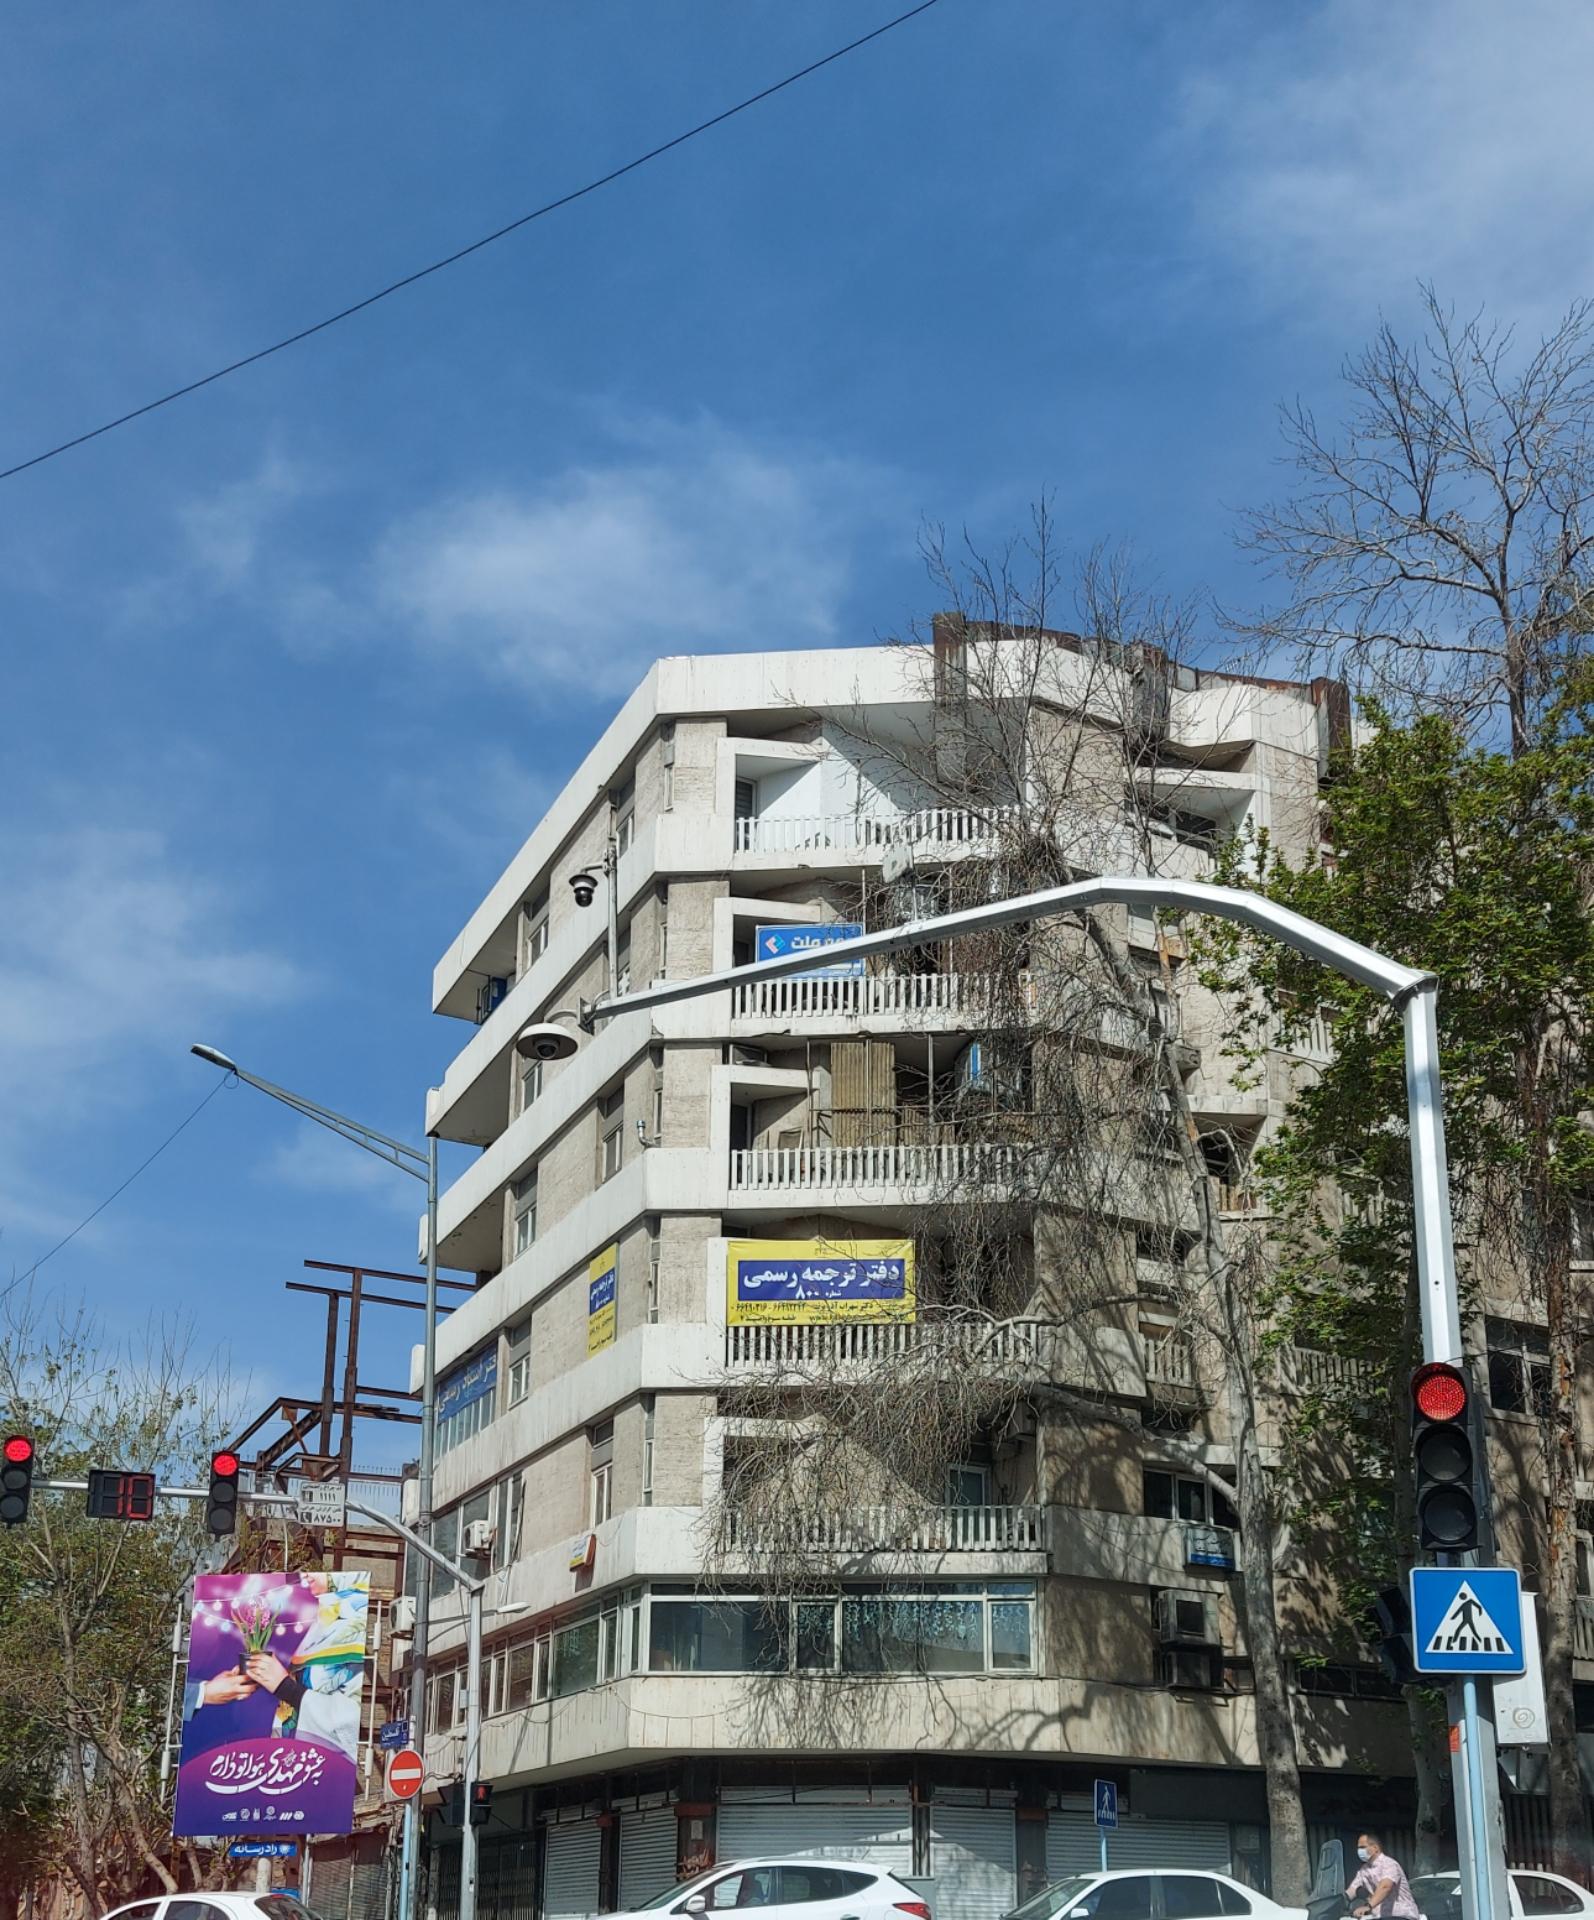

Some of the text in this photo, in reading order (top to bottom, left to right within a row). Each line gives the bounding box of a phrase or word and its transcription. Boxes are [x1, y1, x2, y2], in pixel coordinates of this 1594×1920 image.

[791, 936, 821, 949] ملت
[743, 1261, 900, 1289] دفتر ترجمه رسمی
[795, 1284, 819, 1300] ۸۰۰
[313, 1513, 341, 1524] ۸۷۵۰۰
